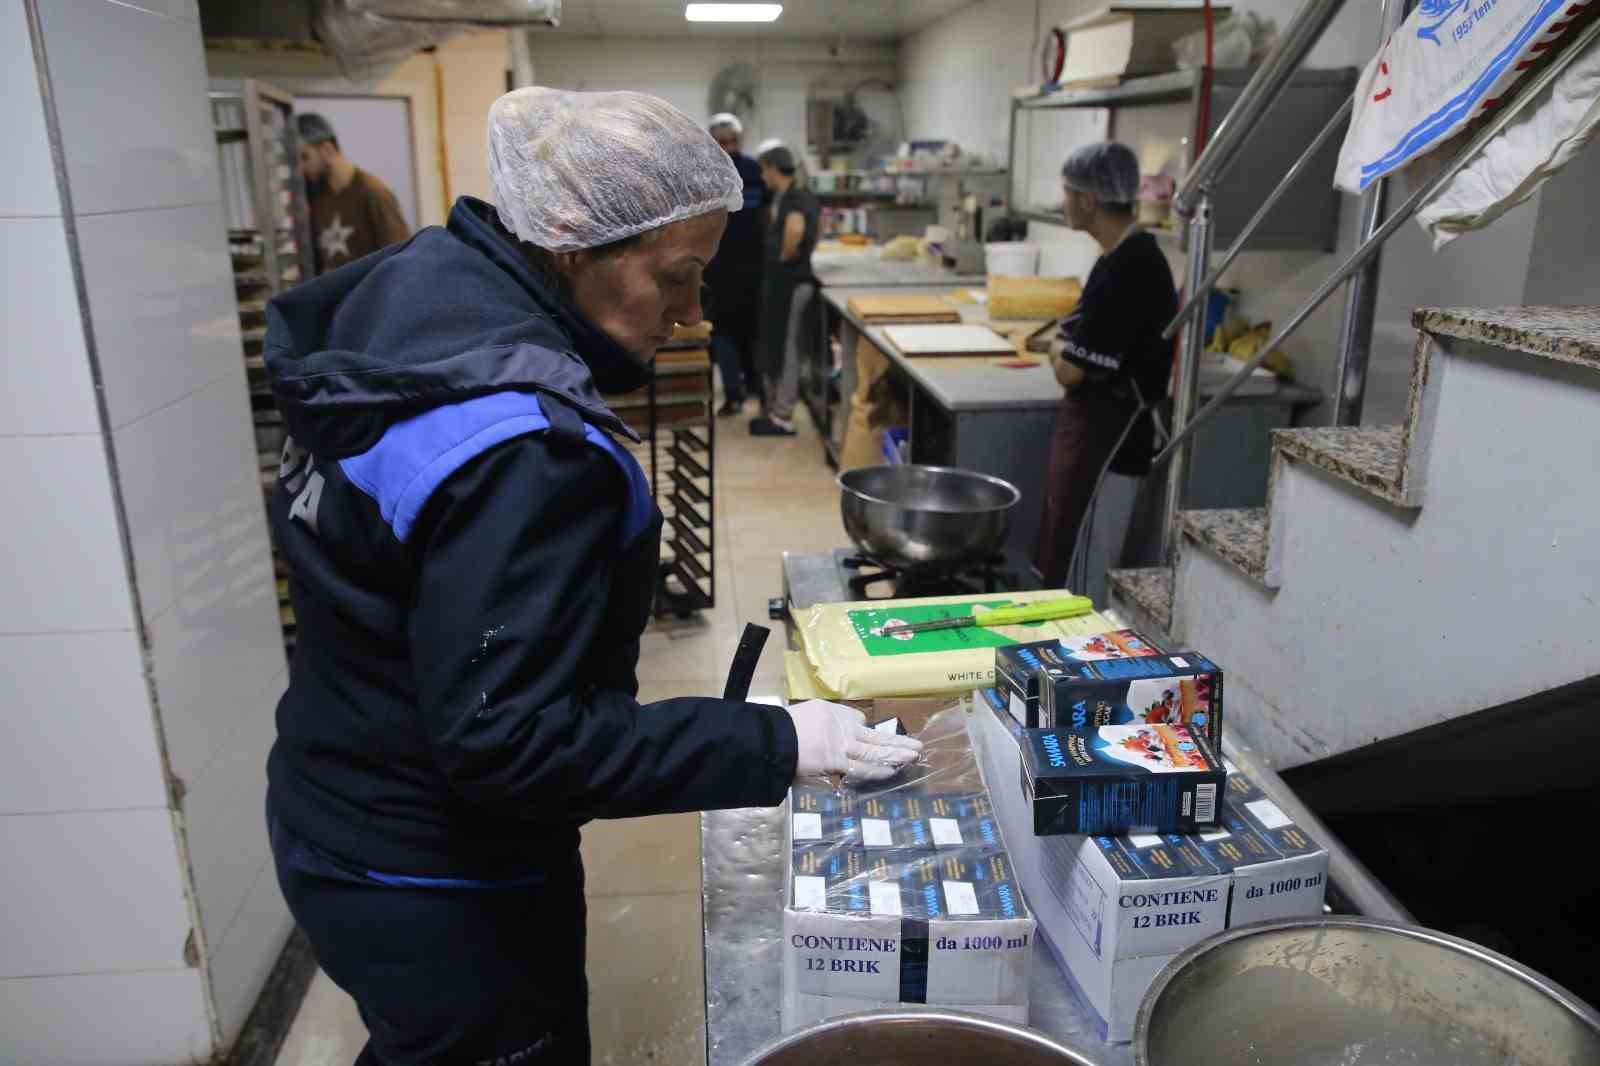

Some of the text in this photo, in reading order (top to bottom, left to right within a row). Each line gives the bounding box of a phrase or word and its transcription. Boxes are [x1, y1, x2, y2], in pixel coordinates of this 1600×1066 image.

[947, 671, 983, 681] WHITE
[1041, 733, 1067, 768] SAMARA
[1245, 872, 1323, 899] da 1000 ml
[1118, 888, 1219, 909] CONTIENE
[1132, 910, 1202, 929] 12 BRIK
[790, 934, 1028, 953] CONTIENE da 1000 ml
[806, 957, 881, 974] 12 BRIK
